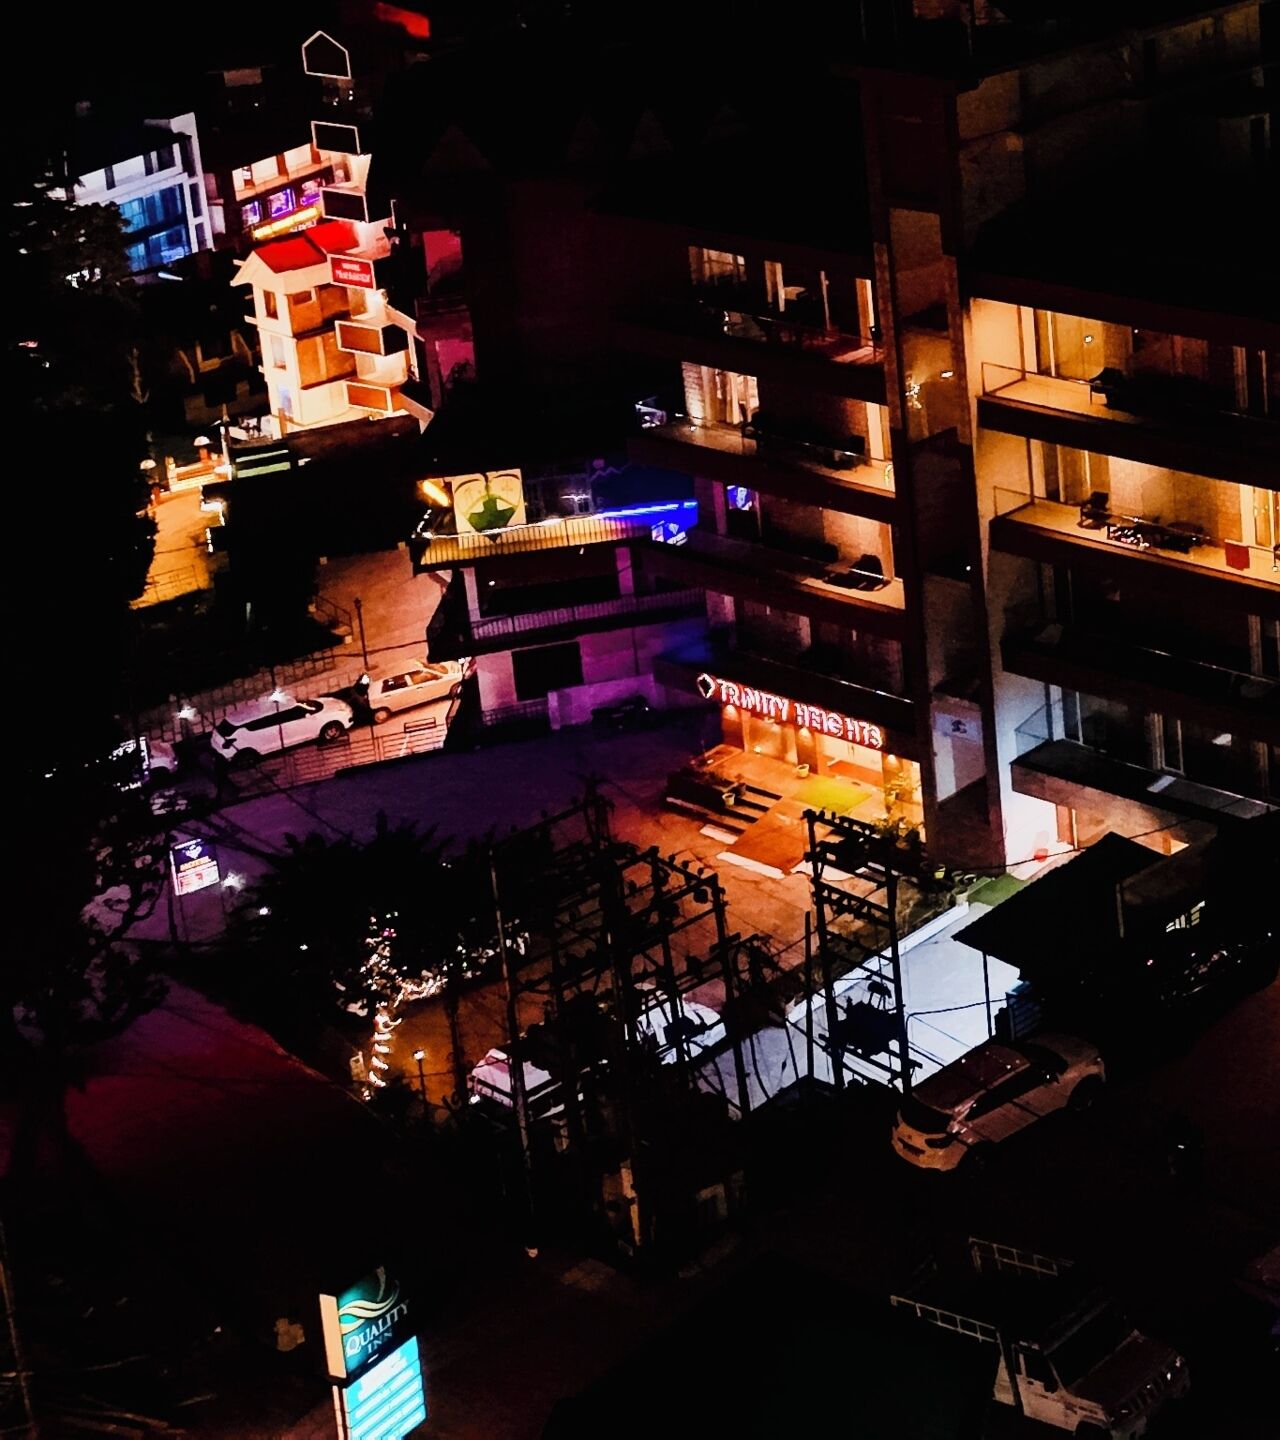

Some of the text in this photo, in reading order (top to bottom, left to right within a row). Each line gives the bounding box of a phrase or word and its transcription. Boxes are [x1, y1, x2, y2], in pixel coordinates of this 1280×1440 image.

[715, 677, 883, 750] TRINITY HEIGHTS
[345, 1299, 410, 1358] QUALITY
[366, 1328, 393, 1354] INN
